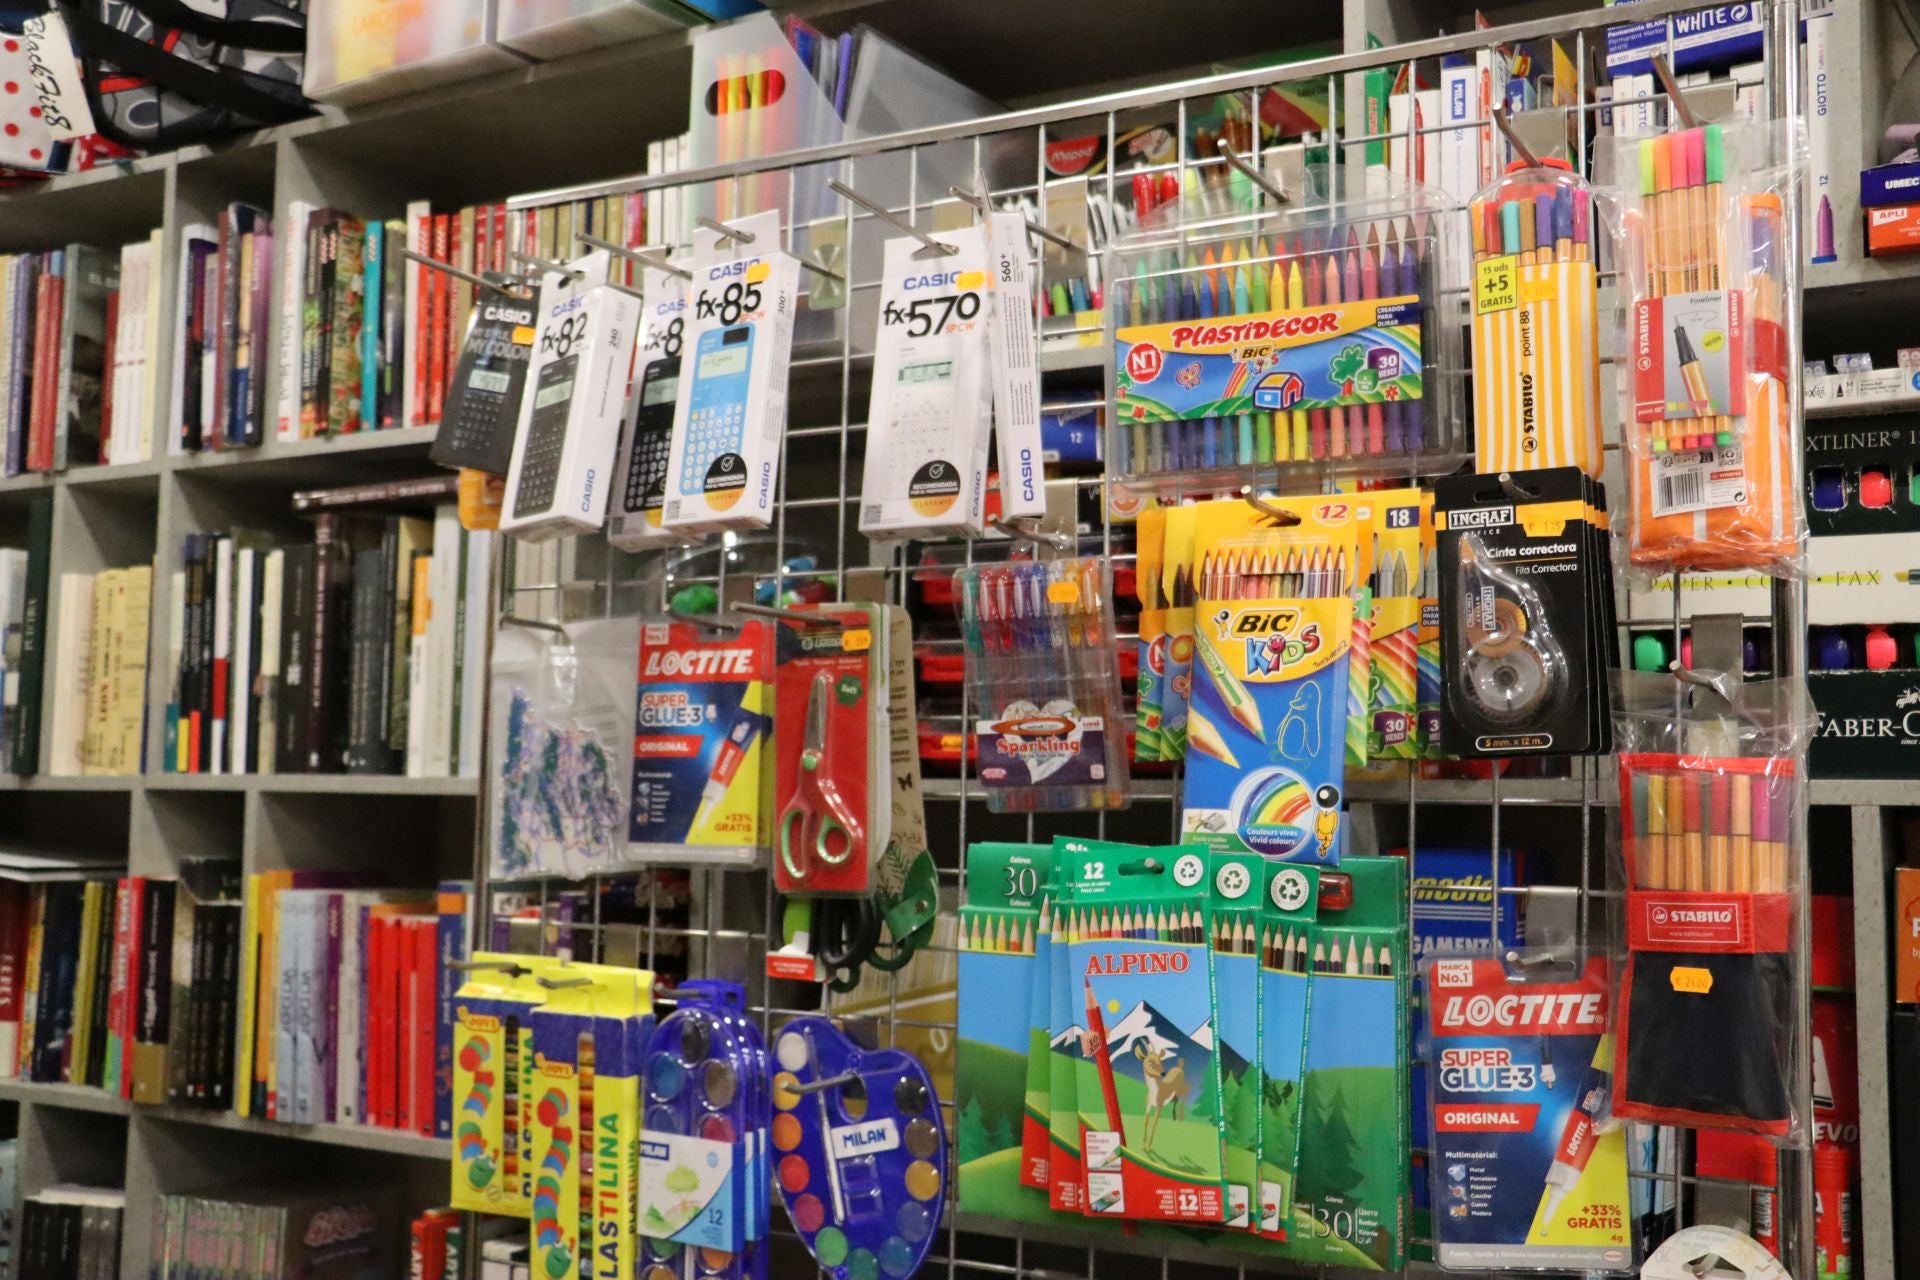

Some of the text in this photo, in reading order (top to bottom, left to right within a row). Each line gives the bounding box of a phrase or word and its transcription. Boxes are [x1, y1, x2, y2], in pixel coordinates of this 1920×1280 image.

[1646, 19, 1667, 30] BLANC
[1676, 7, 1727, 34] WHITE
[1454, 83, 1465, 116] MILAN
[1817, 74, 1827, 116] GIOTTO
[1819, 174, 1829, 187] 12
[1880, 210, 1904, 219] APLI
[1001, 254, 1011, 282] 560+
[1483, 263, 1509, 275] 15 uds
[1484, 275, 1509, 293] +5
[696, 281, 763, 326] fx-85
[1480, 294, 1513, 309] GRATIS
[1730, 293, 1738, 326] STABILO
[484, 306, 532, 325] CASIO
[883, 292, 981, 338] fx-570
[541, 312, 588, 358] fx-82
[644, 317, 684, 359] fx-8
[1638, 305, 1649, 355] STABILO
[1379, 355, 1397, 369] 30
[1520, 310, 1534, 433] STABILO point 88
[1070, 432, 1082, 443] 12
[1806, 430, 1901, 451] XTLINER®
[1021, 449, 1034, 501] CASIO
[581, 468, 595, 513] CASIO
[759, 462, 771, 509] CASIO
[912, 481, 958, 490] RECOMENDADA
[973, 471, 981, 518] CASIO
[1319, 504, 1348, 520] 12
[1389, 508, 1411, 527] 18
[1452, 510, 1509, 526] INGRAF
[1488, 543, 1577, 559] Cinta correctora
[1515, 563, 1577, 575] Fita Correctora
[1836, 571, 1880, 586] FAX
[1483, 587, 1494, 630] INGRAF
[644, 649, 753, 676] LOCTITE
[643, 694, 687, 707] SUPER
[1384, 719, 1405, 733] 30
[1429, 719, 1440, 733] 3
[640, 741, 689, 752] ORIGINAL
[996, 734, 1082, 758] Sparkling
[1485, 738, 1491, 748] 5
[1513, 737, 1520, 746] x
[1520, 736, 1531, 747] 12
[714, 823, 752, 833] GRATIS
[1247, 827, 1298, 837] Couleurs vives
[1269, 836, 1295, 845] colours
[1084, 861, 1105, 880] 12
[1001, 866, 1038, 896] 30
[1671, 911, 1731, 922] STABILO
[1412, 936, 1503, 954] GAMENTO
[1085, 951, 1190, 976] ALPINO
[1441, 963, 1469, 971] MARCA
[1442, 994, 1601, 1026] LOCTITE
[1444, 1050, 1509, 1066] SUPER
[1444, 1112, 1519, 1125] ORIGINAL
[842, 1129, 886, 1147] MILAN
[1567, 1121, 1588, 1156] LOCTITE
[1446, 1151, 1498, 1159] Multimaterial:
[599, 1112, 619, 1280] LASTILINA
[1178, 1193, 1198, 1211] 12
[708, 1207, 723, 1227] 12
[1582, 1205, 1621, 1216] +33%
[1316, 1208, 1352, 1240] 30
[1567, 1218, 1622, 1229] GRATIS
[1611, 1234, 1623, 1243] 4g
